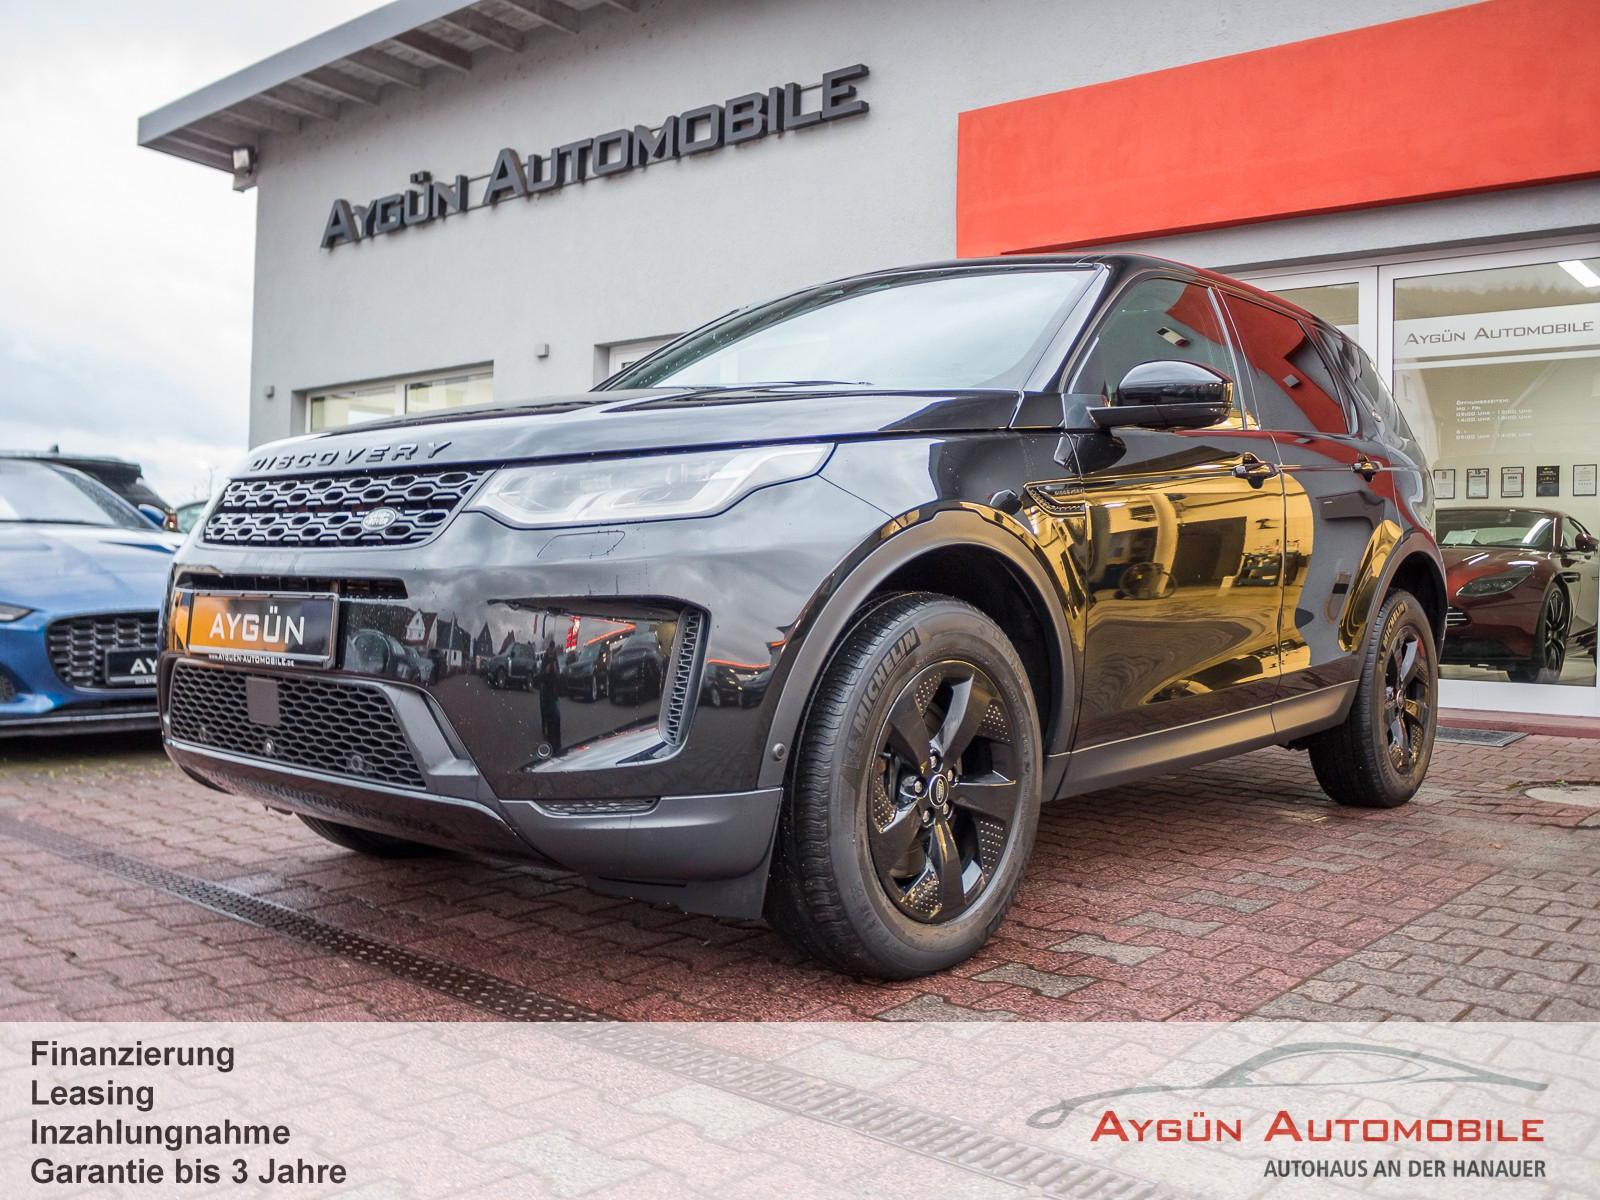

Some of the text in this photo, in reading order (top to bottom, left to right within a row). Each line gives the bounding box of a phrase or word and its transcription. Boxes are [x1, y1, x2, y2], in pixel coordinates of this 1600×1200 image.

[320, 63, 870, 248] AYGÜN AUTOMOBILE
[1404, 320, 1595, 345] AYGÜN AUTOMOBILE
[249, 441, 452, 472] DISCOVERY
[209, 605, 305, 645] AYGÜN
[852, 626, 920, 737] MICHELIN
